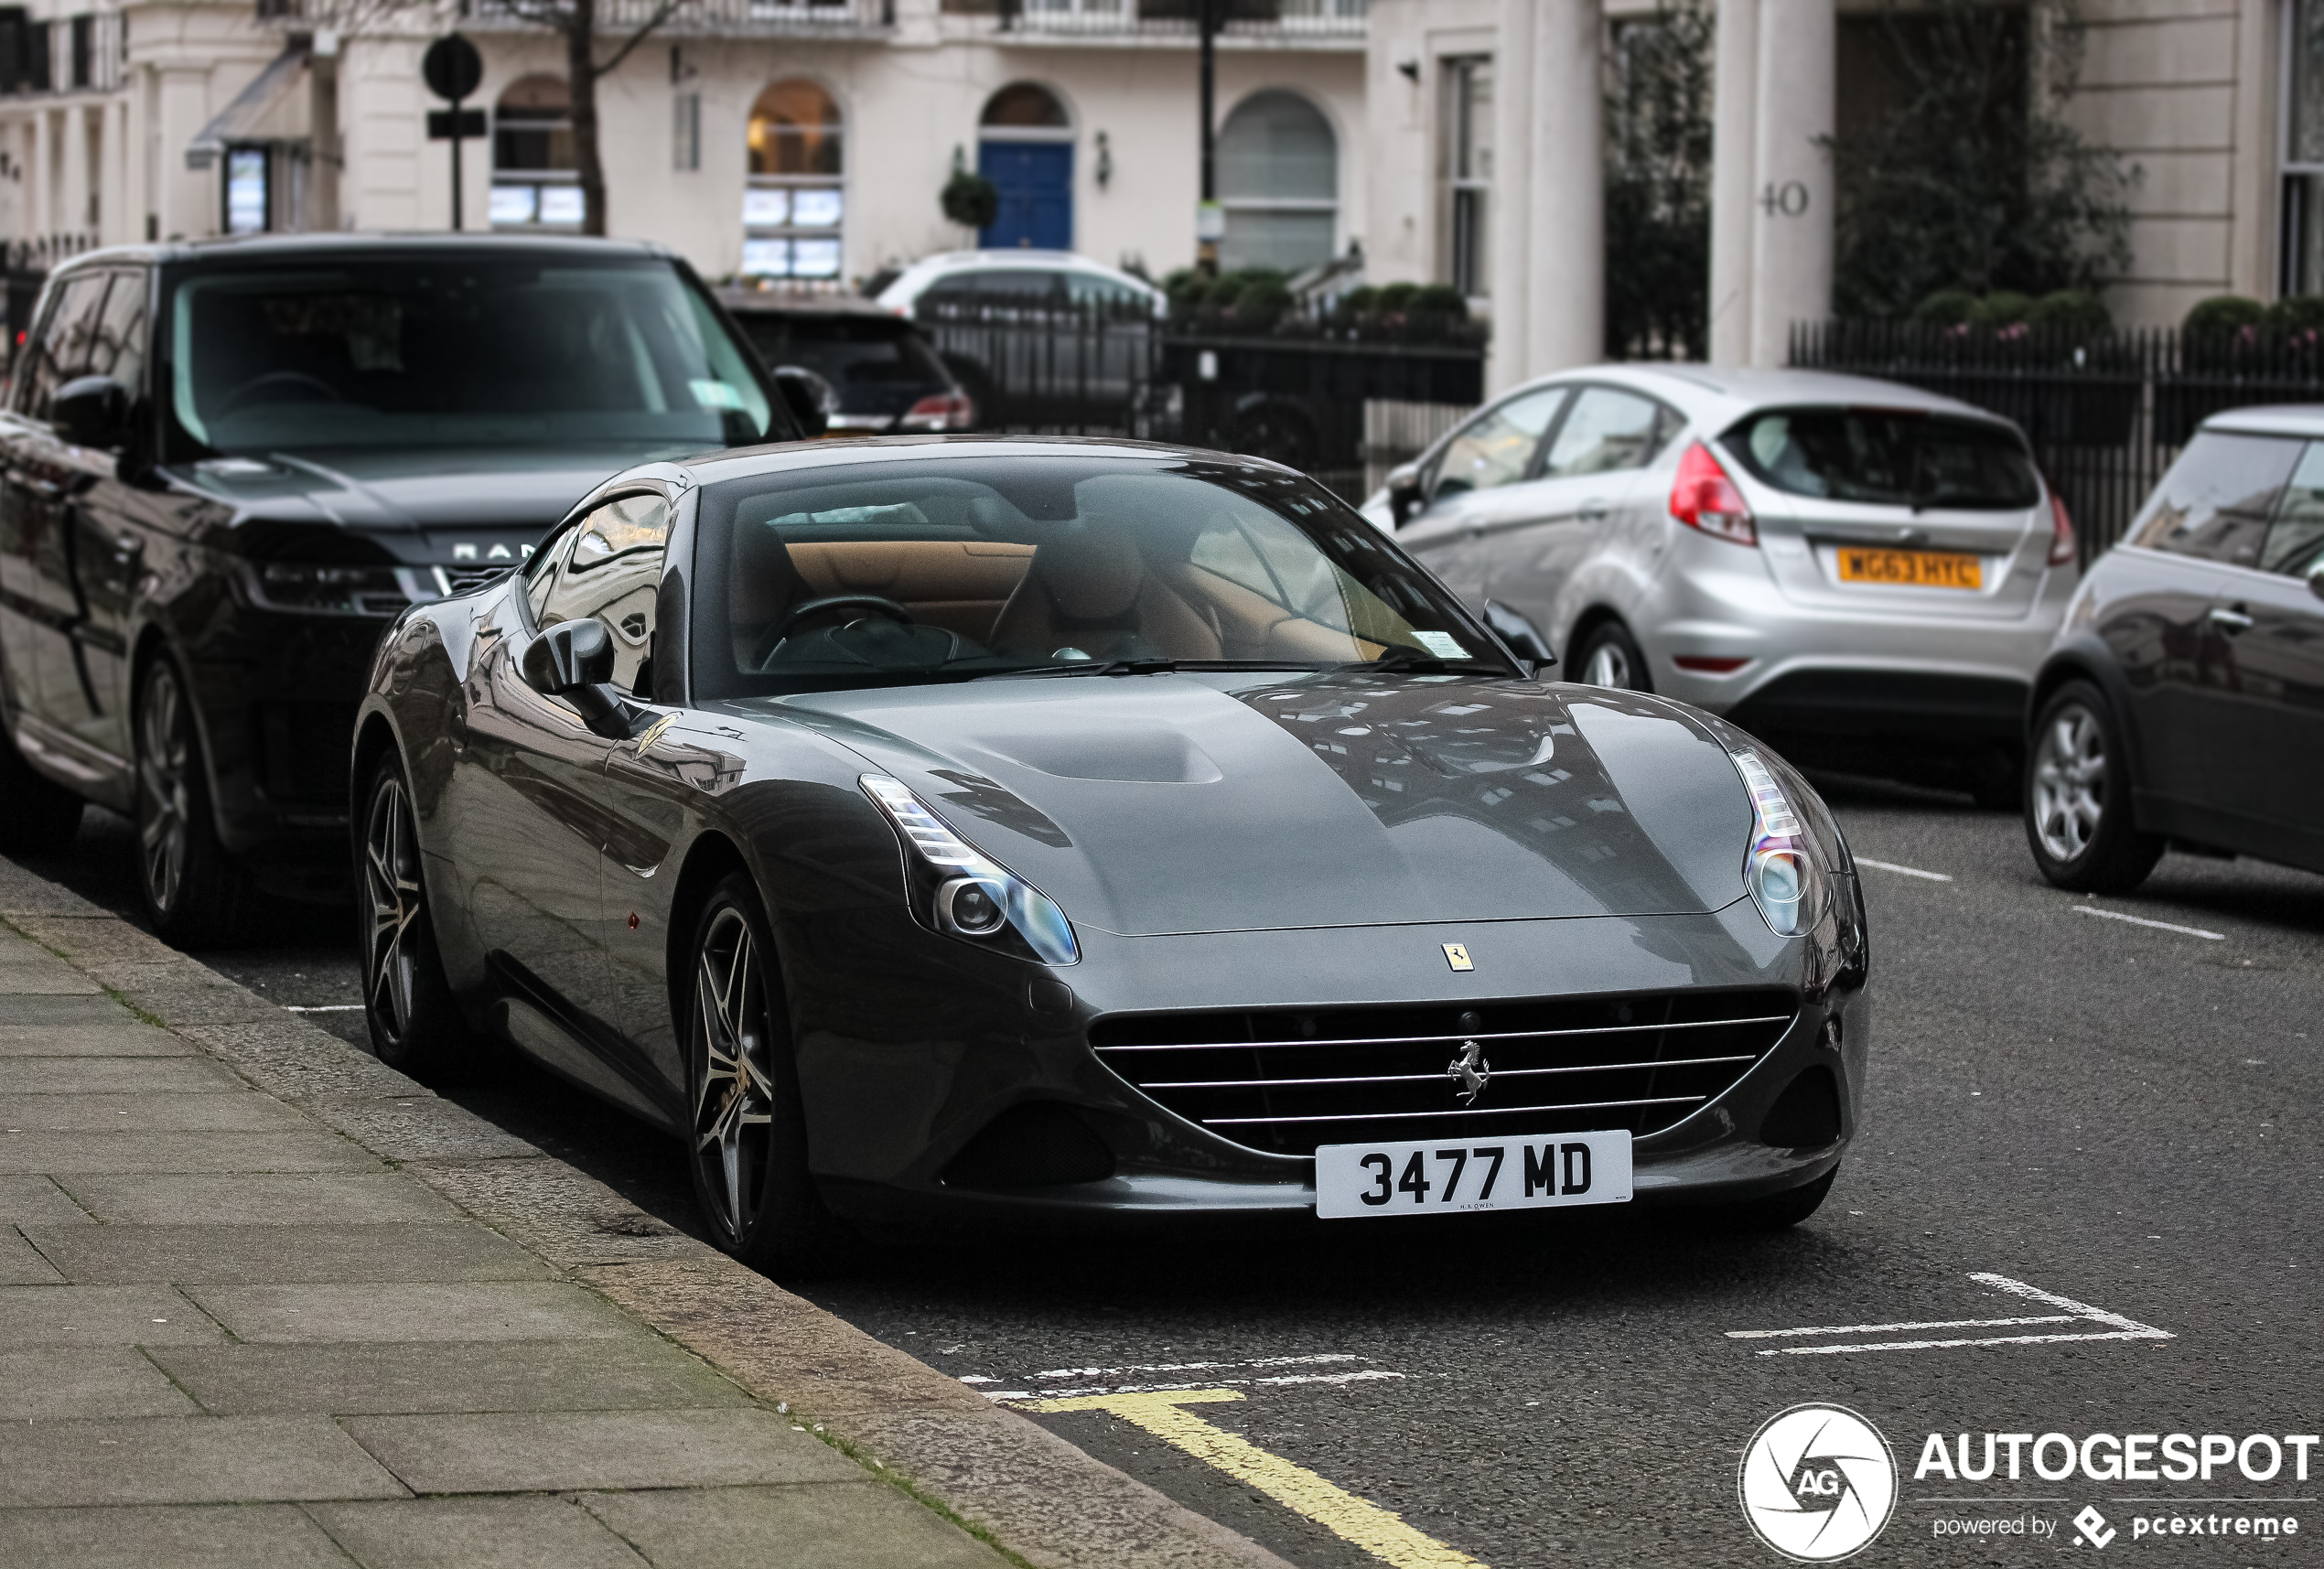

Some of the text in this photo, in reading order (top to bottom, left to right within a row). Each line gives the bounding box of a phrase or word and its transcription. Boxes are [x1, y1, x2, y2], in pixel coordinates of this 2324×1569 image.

[1759, 180, 1810, 219] 40
[1850, 552, 1974, 585] WG63 HYC
[1360, 1142, 1593, 1207] 3477 MD
